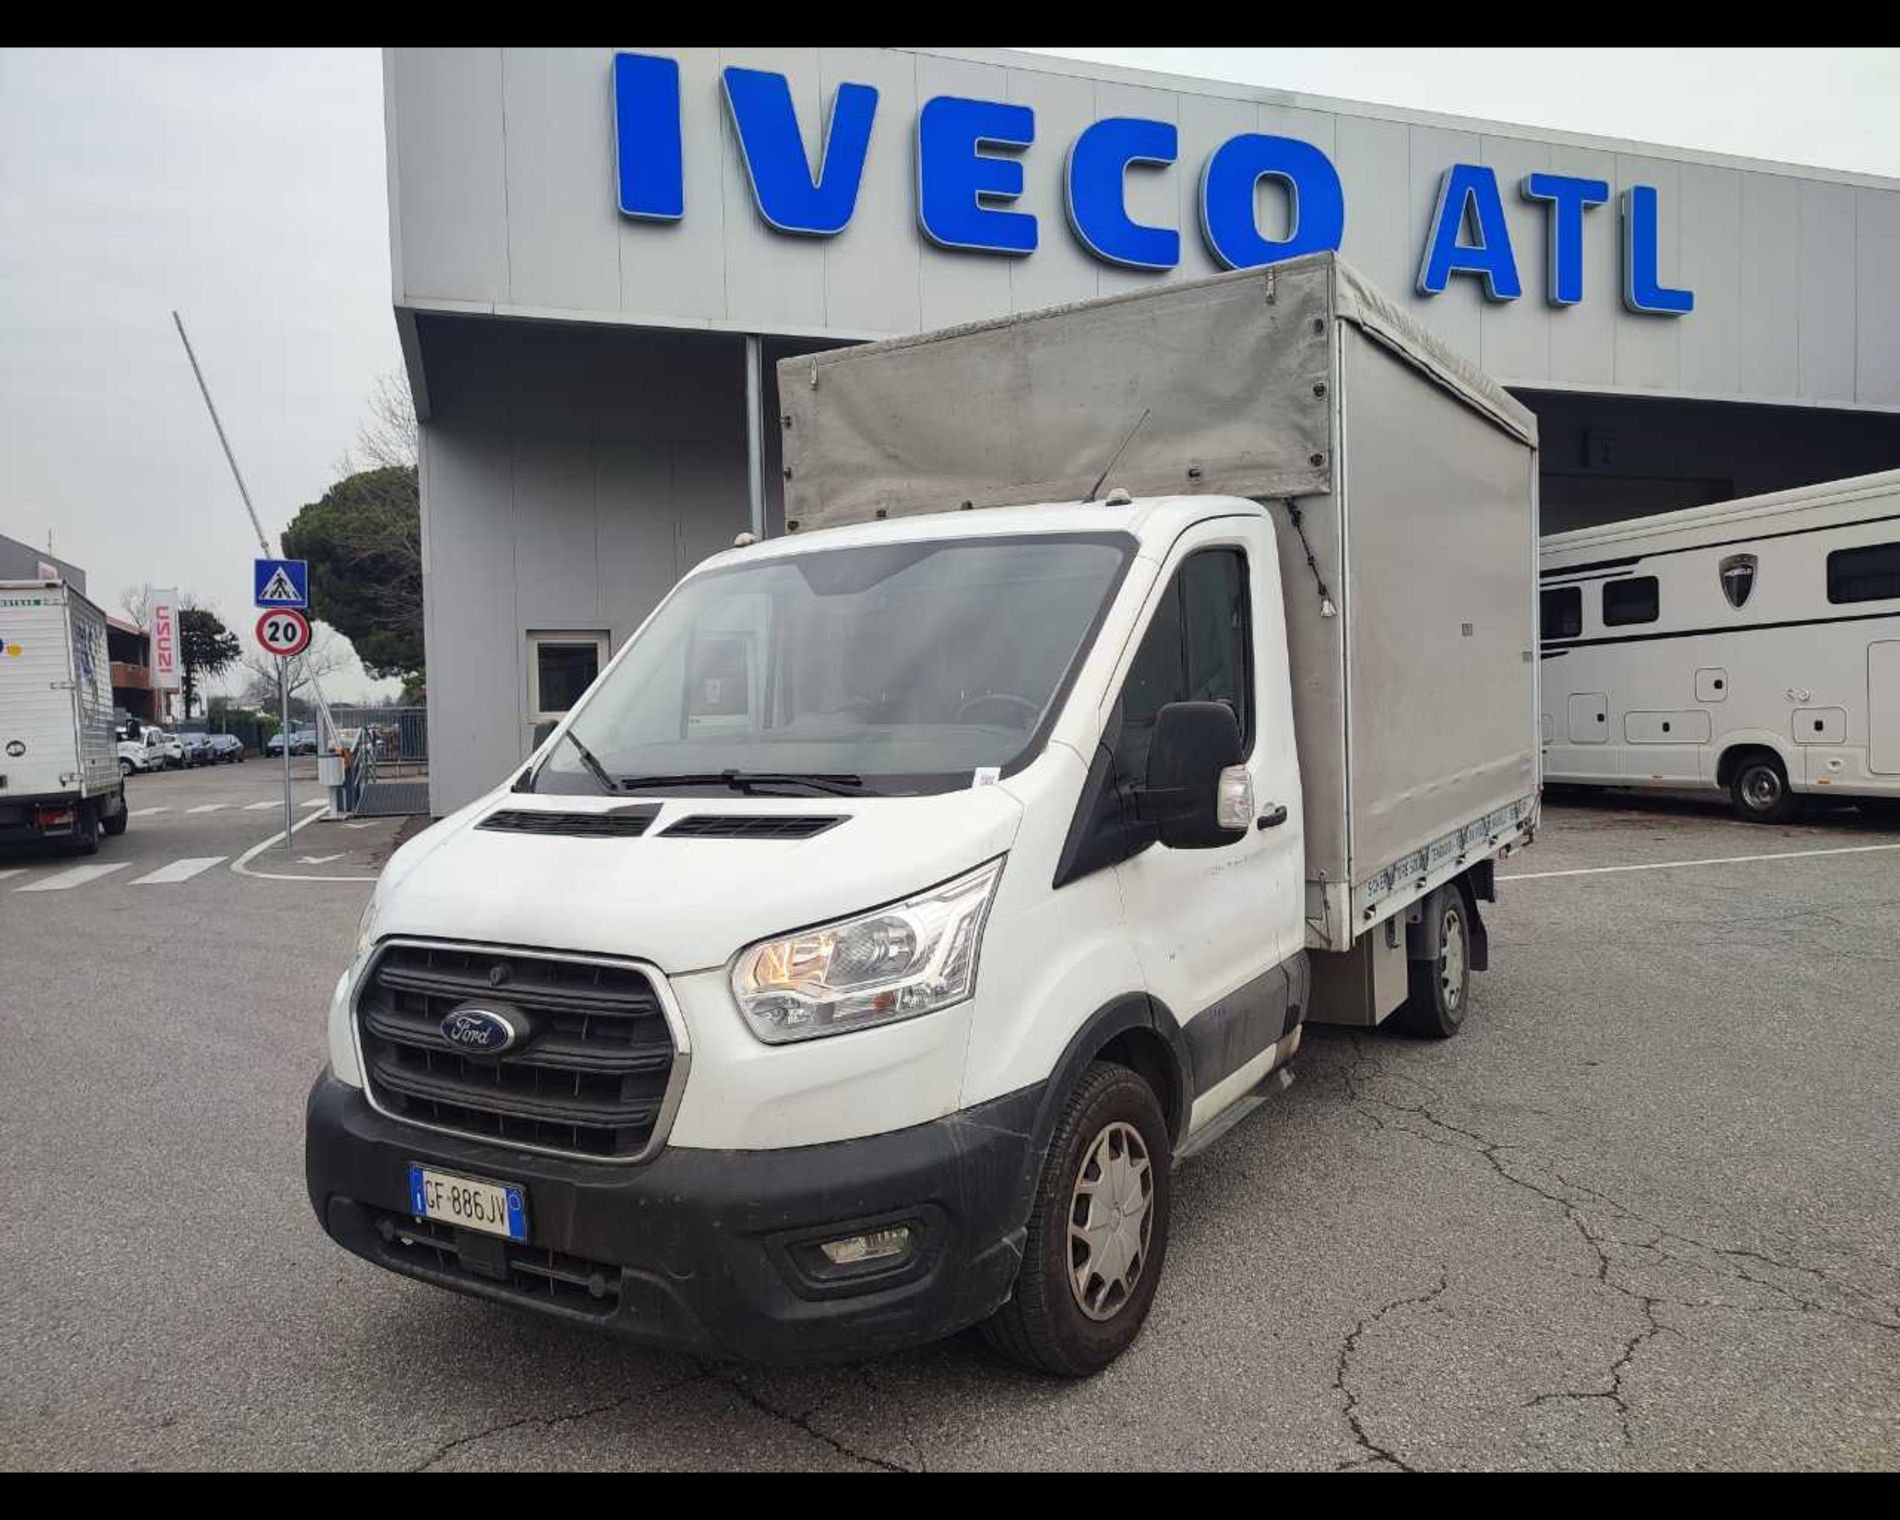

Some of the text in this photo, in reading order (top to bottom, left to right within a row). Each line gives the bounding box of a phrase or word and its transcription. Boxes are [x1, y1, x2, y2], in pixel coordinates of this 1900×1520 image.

[611, 52, 1694, 315] IVECO ATL
[156, 605, 173, 673] ISUZU
[268, 621, 297, 642] 20
[451, 1016, 492, 1045] Ford
